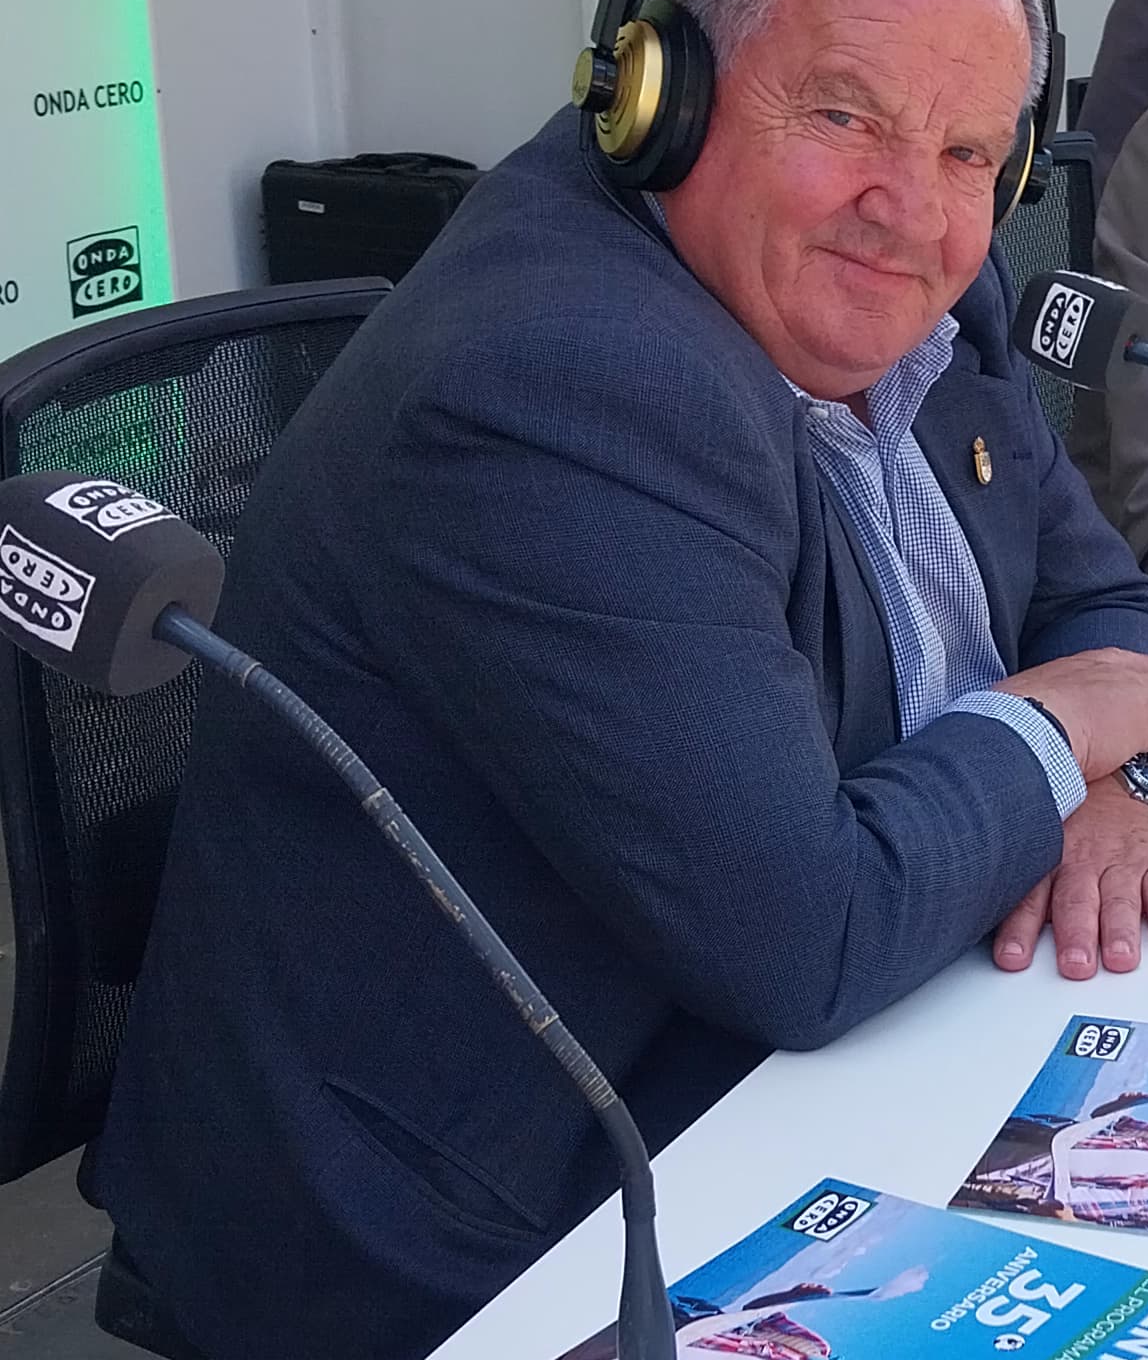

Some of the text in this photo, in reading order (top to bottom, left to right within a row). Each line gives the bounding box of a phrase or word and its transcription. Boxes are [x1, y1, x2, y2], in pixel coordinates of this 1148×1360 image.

[34, 80, 144, 117] ONDA CERO
[78, 246, 129, 270] ONDA
[84, 275, 131, 300] CERO
[1040, 297, 1066, 346] ONDA
[1059, 303, 1081, 350] CERO
[9, 551, 70, 596] CERO
[1, 579, 64, 628] ONDA
[1077, 1028, 1098, 1054] CERO
[1098, 1028, 1119, 1055] ONDA
[799, 1195, 836, 1226] CERO
[813, 1202, 856, 1233] ONDA
[931, 1246, 1039, 1331] ANIVERSARIO
